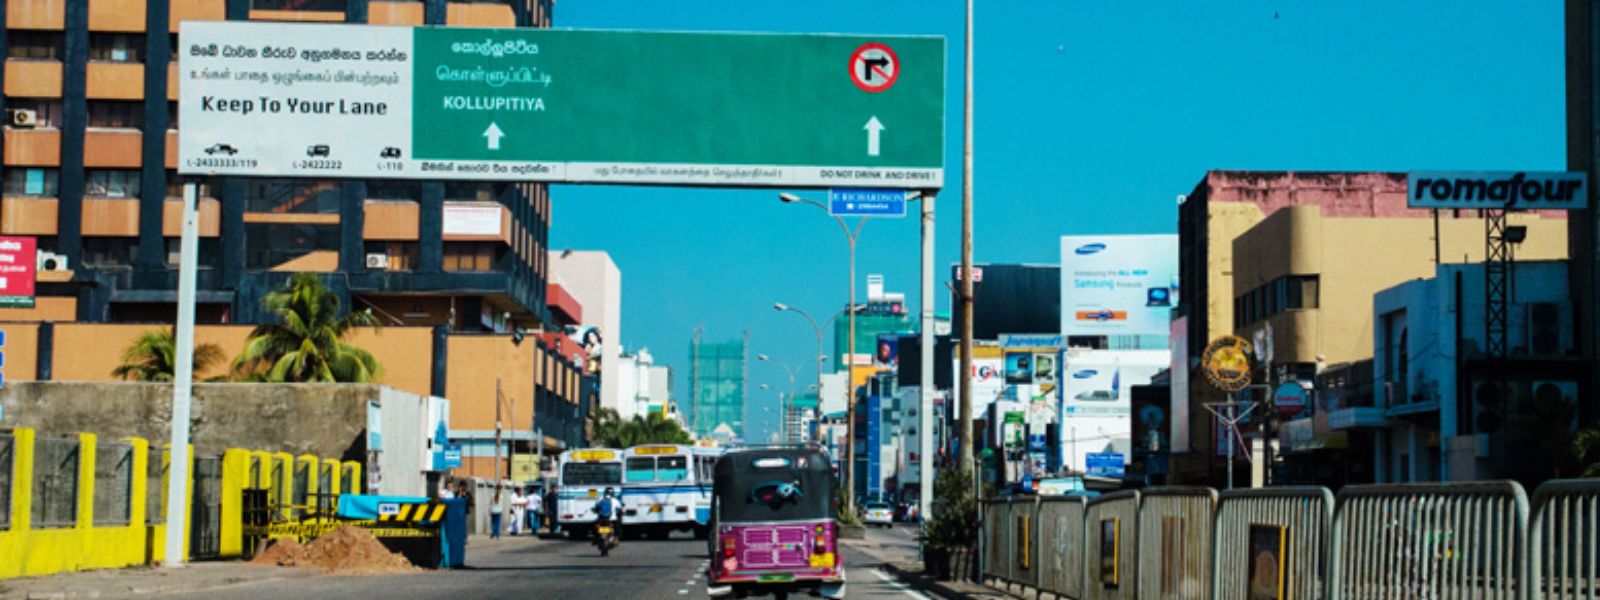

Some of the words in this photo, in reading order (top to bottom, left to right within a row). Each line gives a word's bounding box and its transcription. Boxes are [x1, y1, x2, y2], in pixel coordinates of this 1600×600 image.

[202, 96, 254, 115] Keep
[260, 97, 281, 114] To
[287, 98, 335, 114] Your
[340, 99, 388, 115] Lane
[444, 96, 545, 111] KOLLUPITIYA
[820, 170, 835, 179] DO
[836, 170, 854, 179] NOT
[855, 171, 882, 180] DRINK
[885, 171, 905, 180] AND
[906, 172, 930, 181] DRIVE
[1415, 173, 1583, 207] romafour
